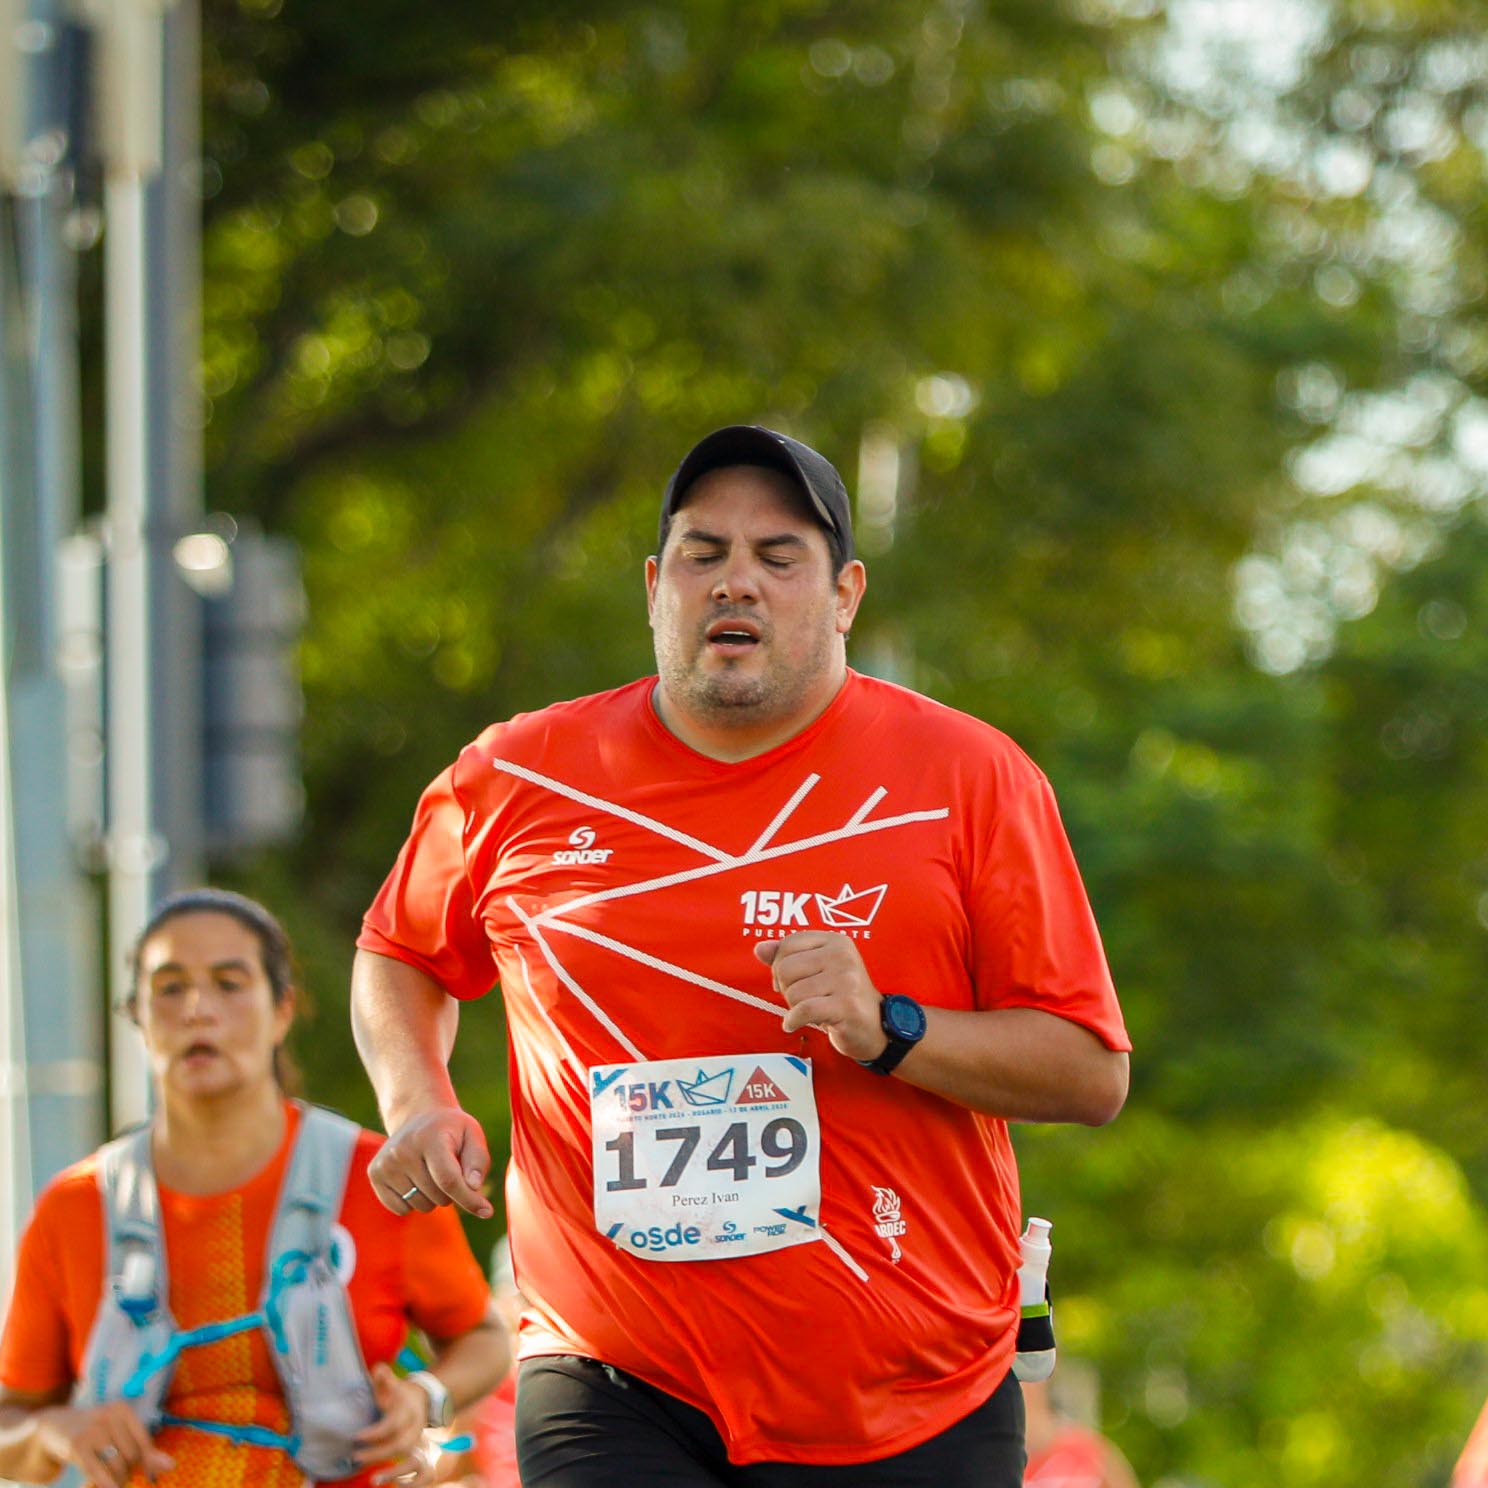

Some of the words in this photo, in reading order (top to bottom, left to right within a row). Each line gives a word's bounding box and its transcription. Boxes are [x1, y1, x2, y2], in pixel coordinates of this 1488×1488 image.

[740, 890, 812, 926] 15K
[742, 928, 806, 938] PUER
[614, 1081, 674, 1111] 15K
[746, 1083, 776, 1099] 15K
[605, 1117, 808, 1192] 1749
[672, 1193, 708, 1207] Perez
[712, 1191, 740, 1205] Ivan
[630, 1221, 702, 1250] osde
